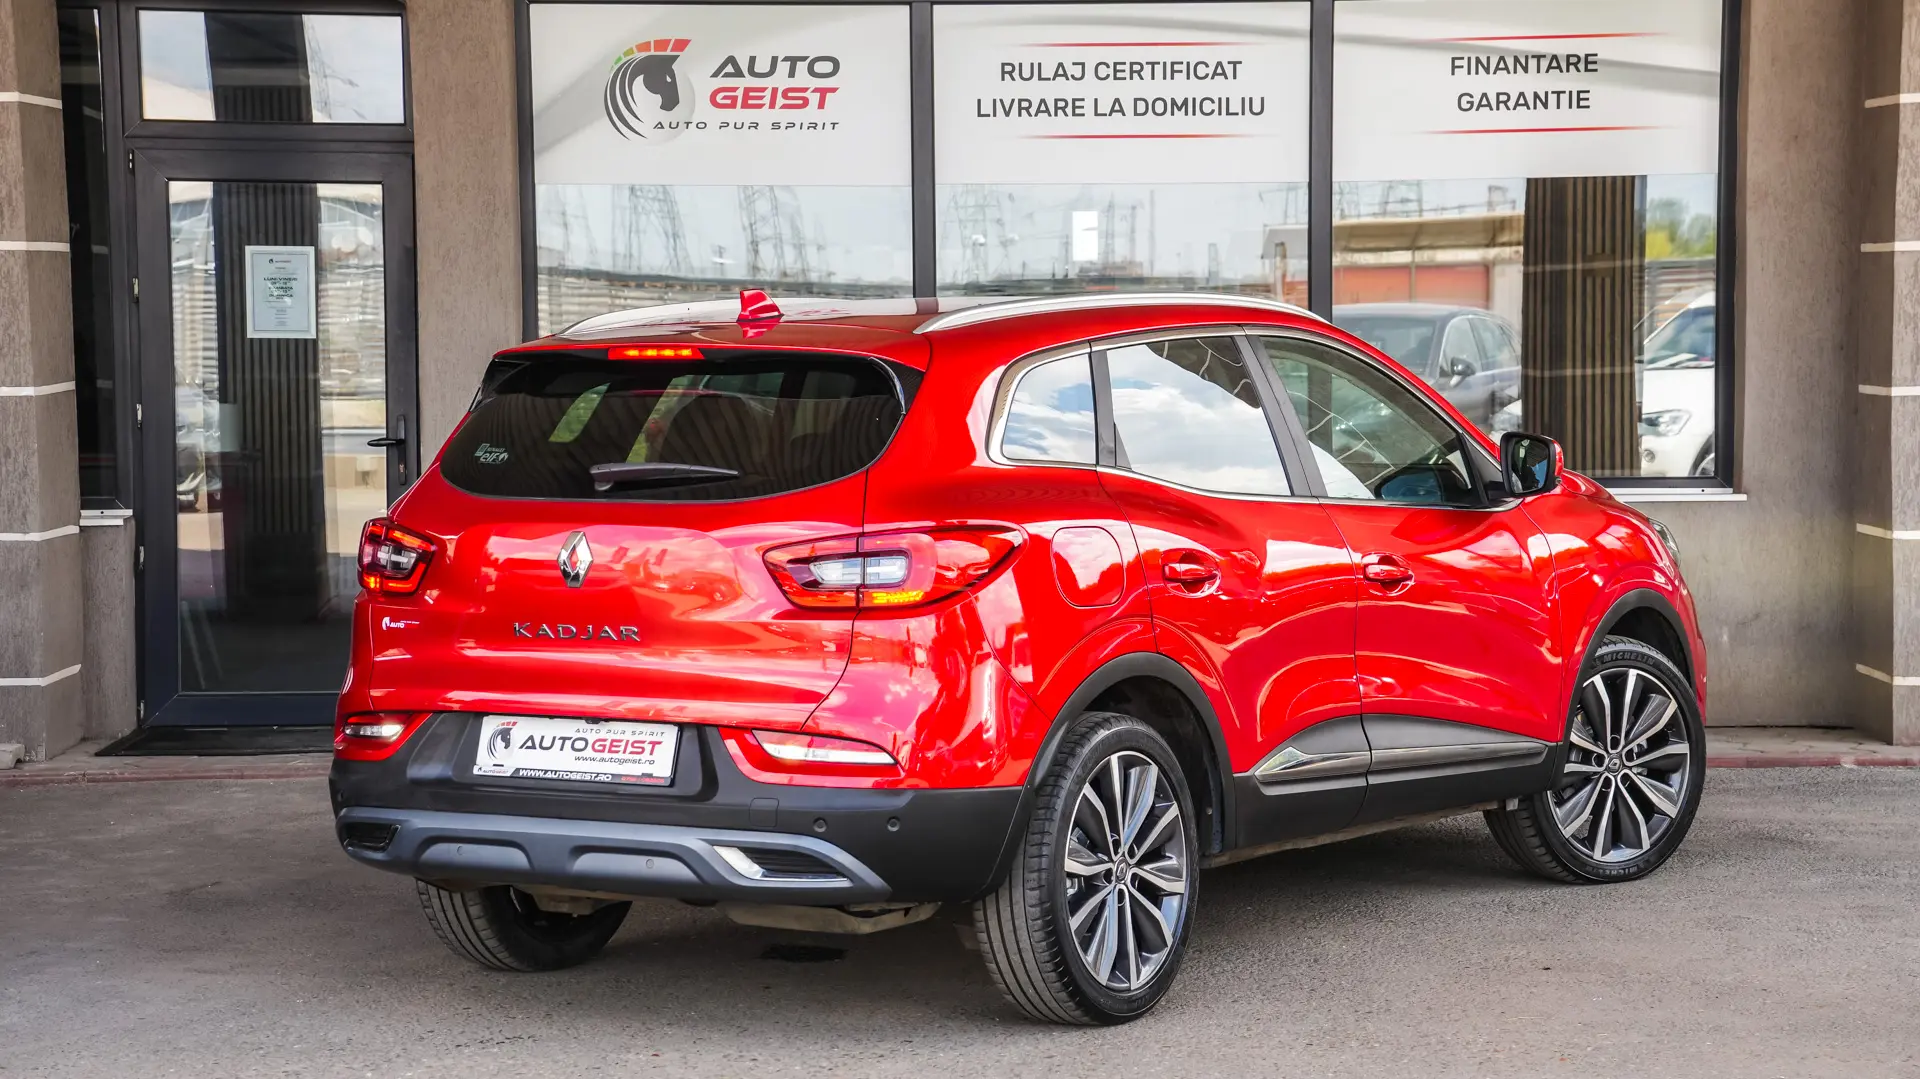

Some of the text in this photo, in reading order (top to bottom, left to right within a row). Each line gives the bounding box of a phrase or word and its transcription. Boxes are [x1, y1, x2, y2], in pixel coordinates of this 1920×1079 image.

[709, 55, 840, 78] AUTO
[1000, 61, 1242, 81] RULAJ CERTIFICAT
[1451, 53, 1599, 75] FINANTARE
[709, 87, 840, 110] GEIST
[976, 97, 1266, 117] LIVRARE LA DOMICILIU
[1457, 90, 1591, 112] GARANTIE
[653, 121, 840, 130] AUTO PUR SPIRIT
[513, 622, 641, 641] KADJAR
[1603, 651, 1655, 665] MICHELIN
[574, 755, 655, 765] www.autogeist.ro
[519, 768, 612, 781] WWW.AUTOGEIST.RO
